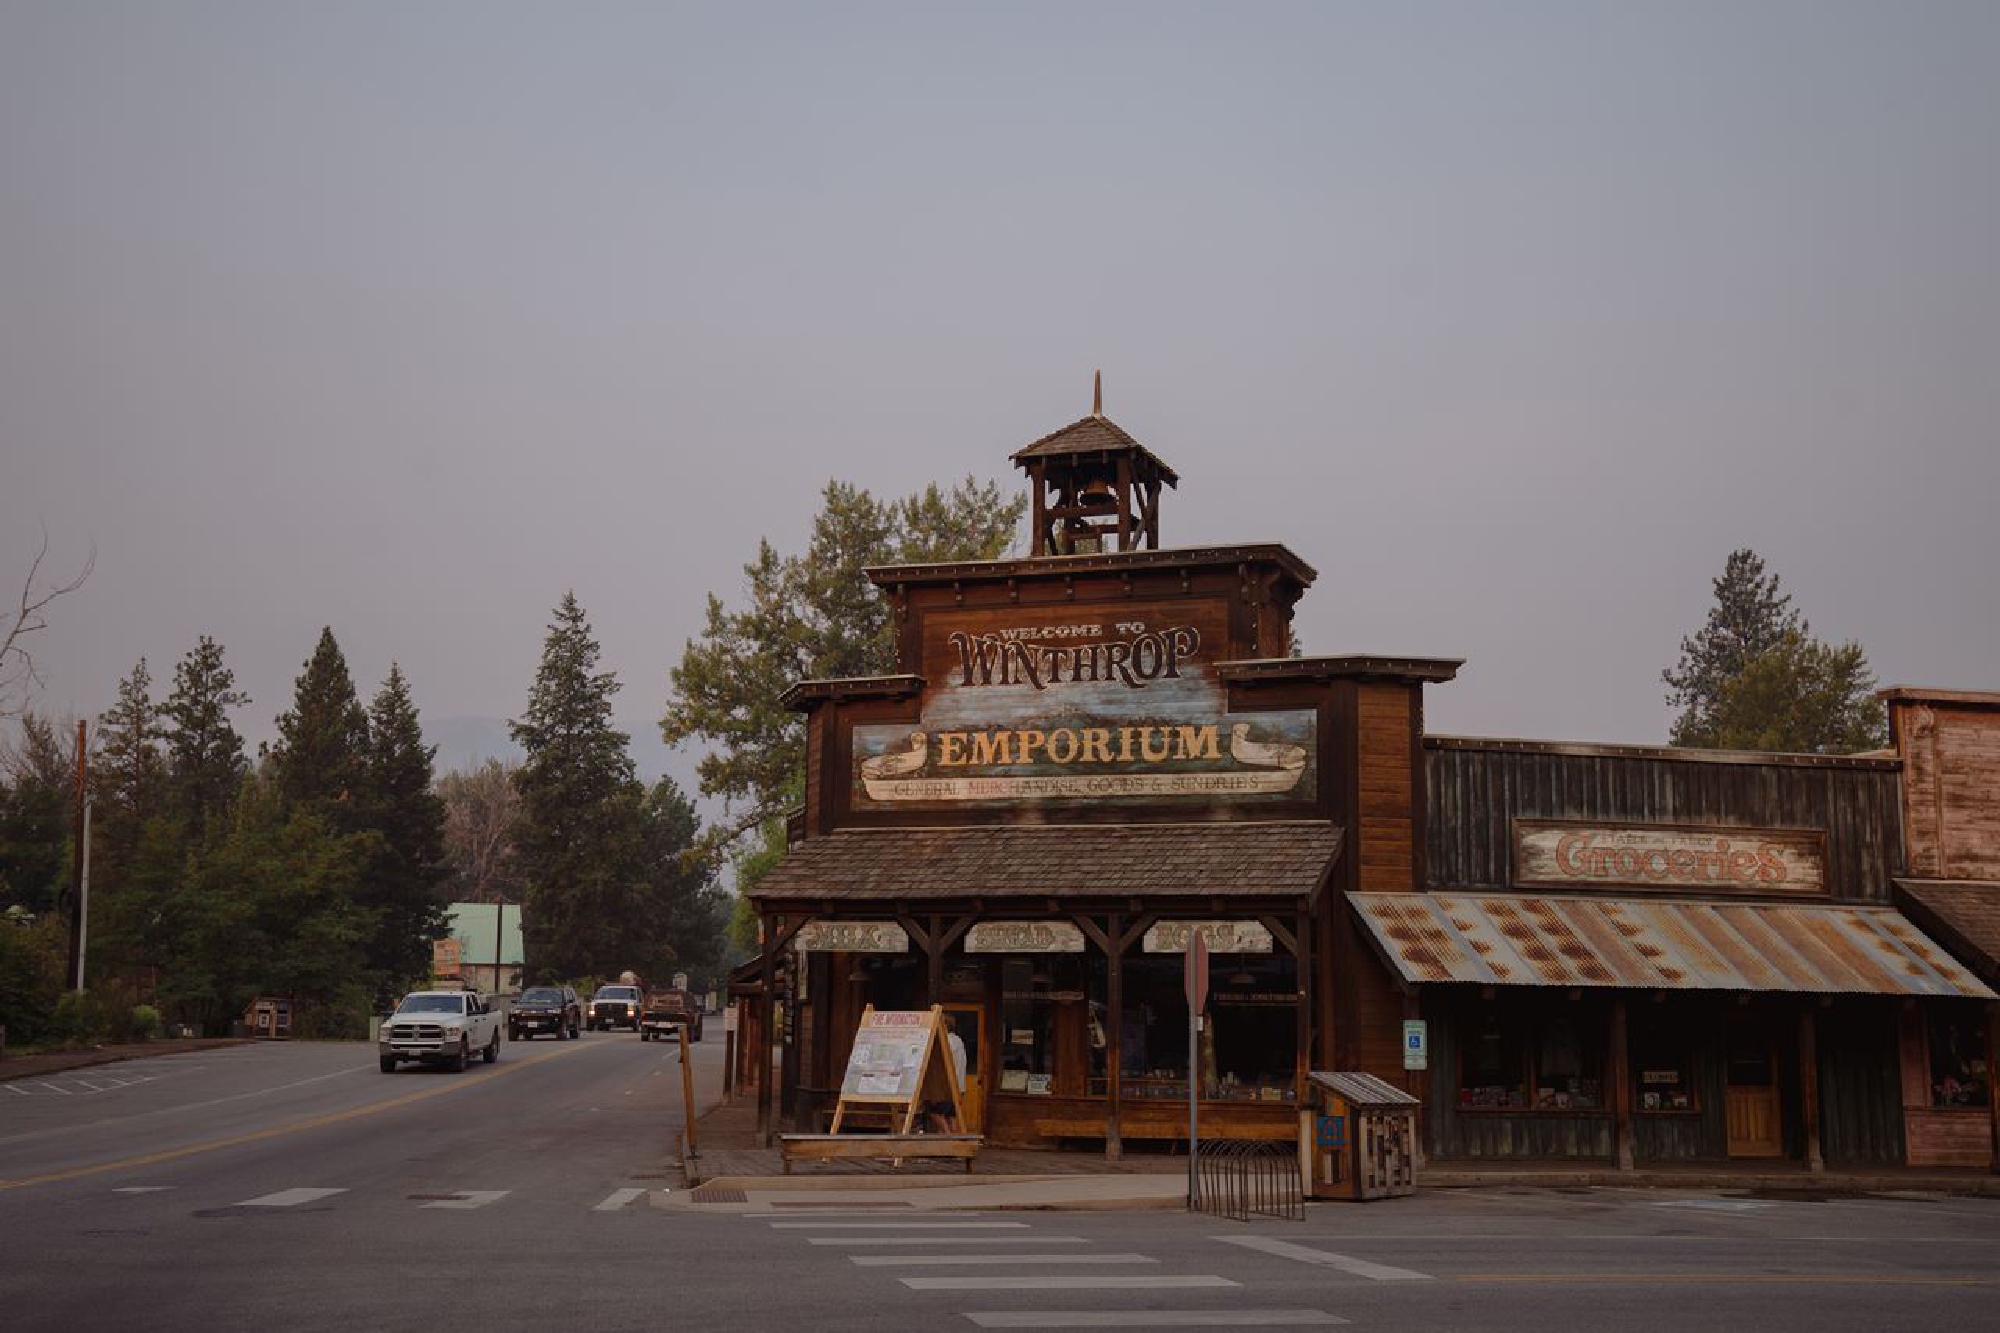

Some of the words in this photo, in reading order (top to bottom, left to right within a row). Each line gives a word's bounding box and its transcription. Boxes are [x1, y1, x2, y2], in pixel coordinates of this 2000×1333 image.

[1000, 624, 1103, 640] WELCOME
[1115, 621, 1146, 635] TO
[949, 626, 1201, 690] WINTHROP
[936, 724, 1223, 767] EMPORIUM
[893, 781, 961, 796] GENERAL
[1087, 776, 1144, 793] GOODS
[1152, 777, 1163, 793] &
[1171, 774, 1260, 791] SUNDRIES
